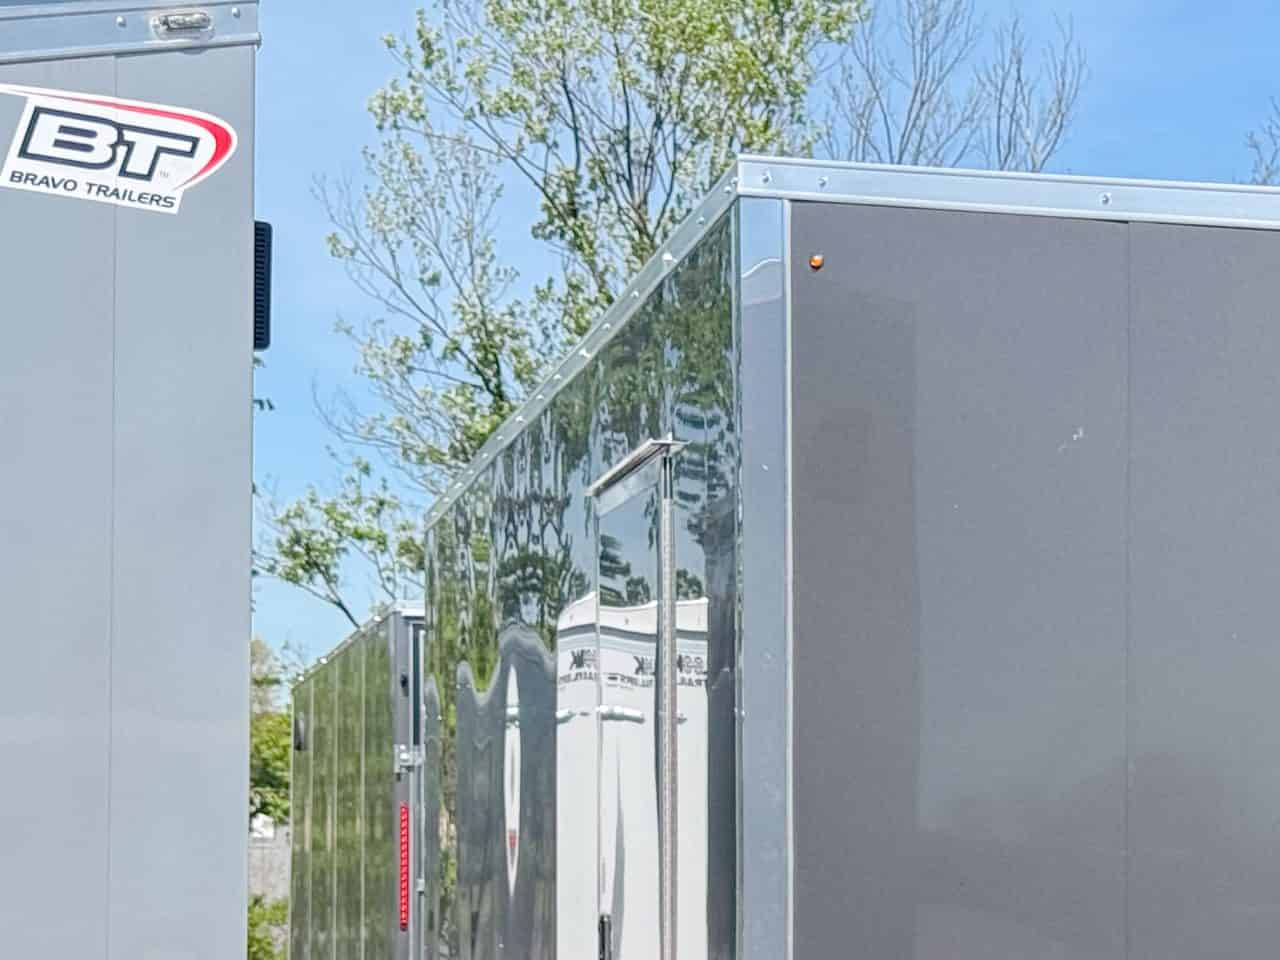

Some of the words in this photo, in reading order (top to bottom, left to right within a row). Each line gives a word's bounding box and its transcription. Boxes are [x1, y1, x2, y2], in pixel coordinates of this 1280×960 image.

[18, 106, 200, 181] BT
[9, 170, 78, 191] BRAVO
[86, 182, 176, 208] TRAILERS
